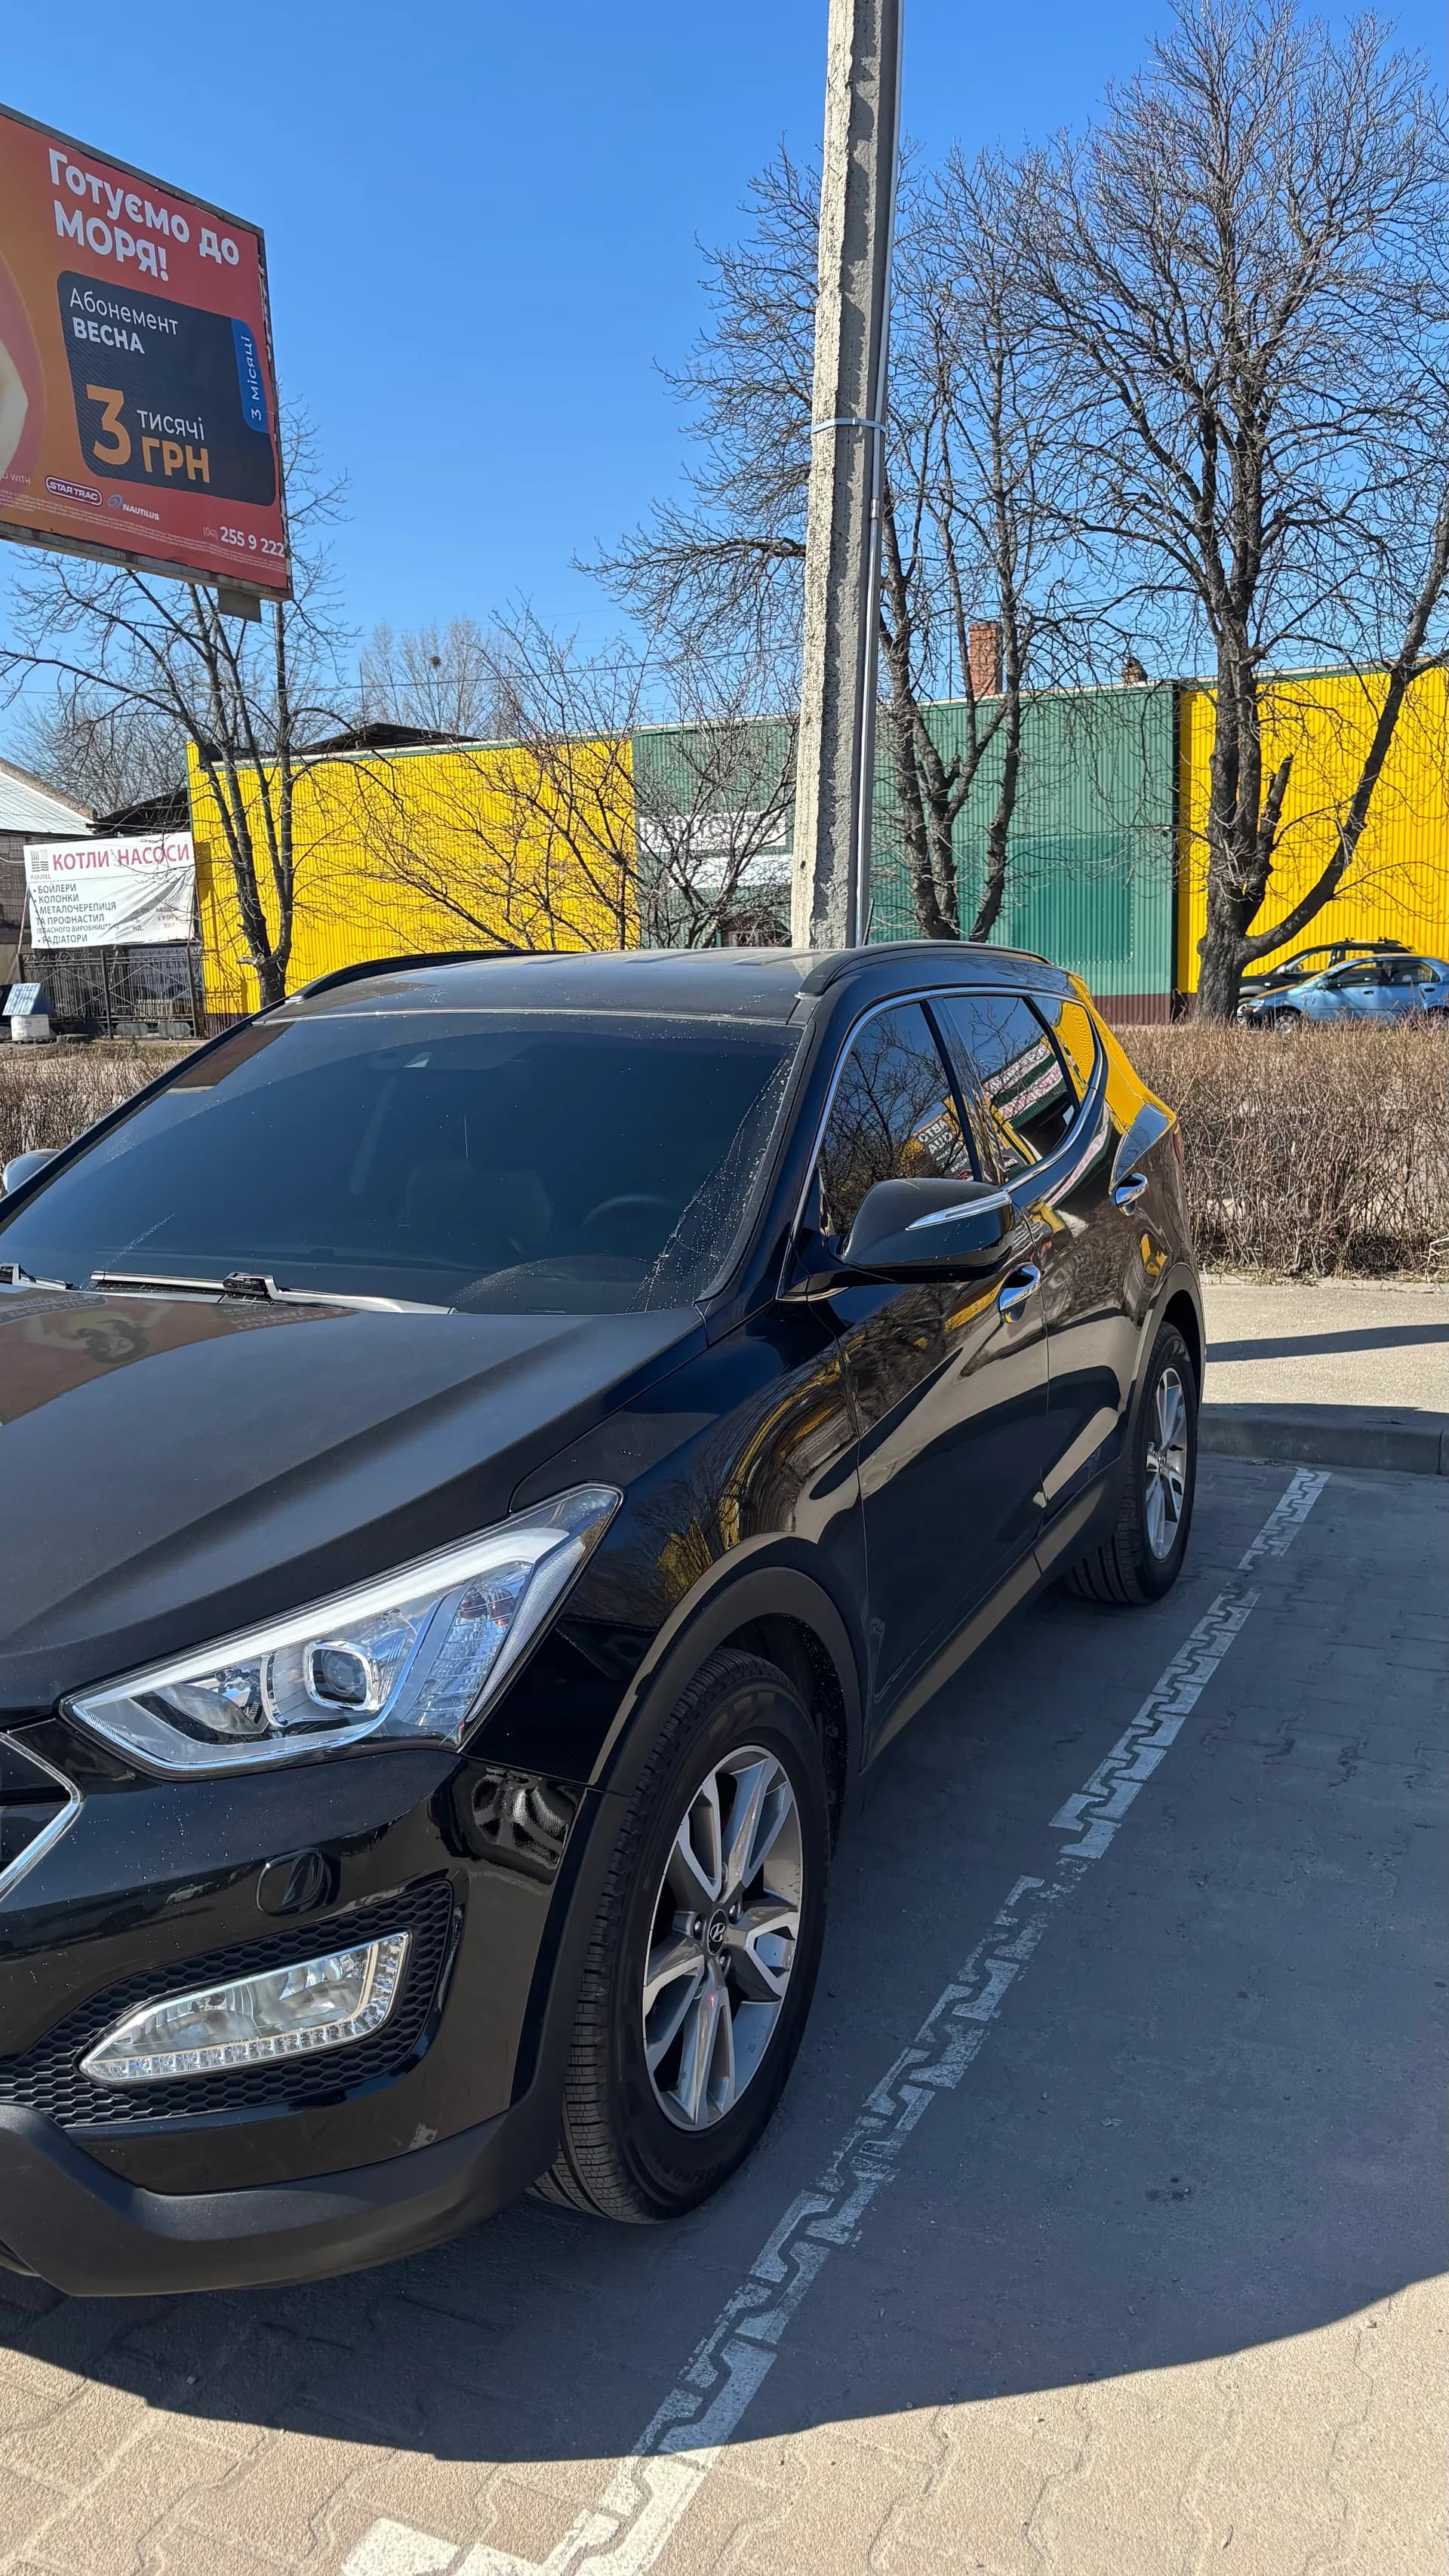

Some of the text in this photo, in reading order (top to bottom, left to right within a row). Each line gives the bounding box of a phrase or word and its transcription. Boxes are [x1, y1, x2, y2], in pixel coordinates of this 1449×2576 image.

[48, 148, 239, 265] Готуємо до
[54, 199, 169, 282] МОРЯ!
[69, 288, 178, 335] Абонемент
[72, 316, 145, 354] ВЕСНА
[251, 408, 261, 420] 3
[86, 383, 131, 465] 3
[142, 436, 211, 483] ГРН
[10, 473, 31, 485] WITH
[48, 482, 99, 500] STAR TRAC
[122, 503, 160, 521] NAUTILUS
[220, 526, 245, 547] 255
[248, 534, 257, 550] 9
[260, 537, 285, 559] 222
[53, 844, 189, 870] КОТЛИ НАСОСИ
[38, 883, 76, 894] БОЙЛЕРИ
[38, 894, 79, 903] КОЛОНКИ
[39, 901, 116, 915] МЕТАЛОЧЕРЕПИЦЯ
[35, 913, 104, 925] ТА ПРОФНАСТИЛ
[42, 934, 88, 945] РАДІАТОРИ
